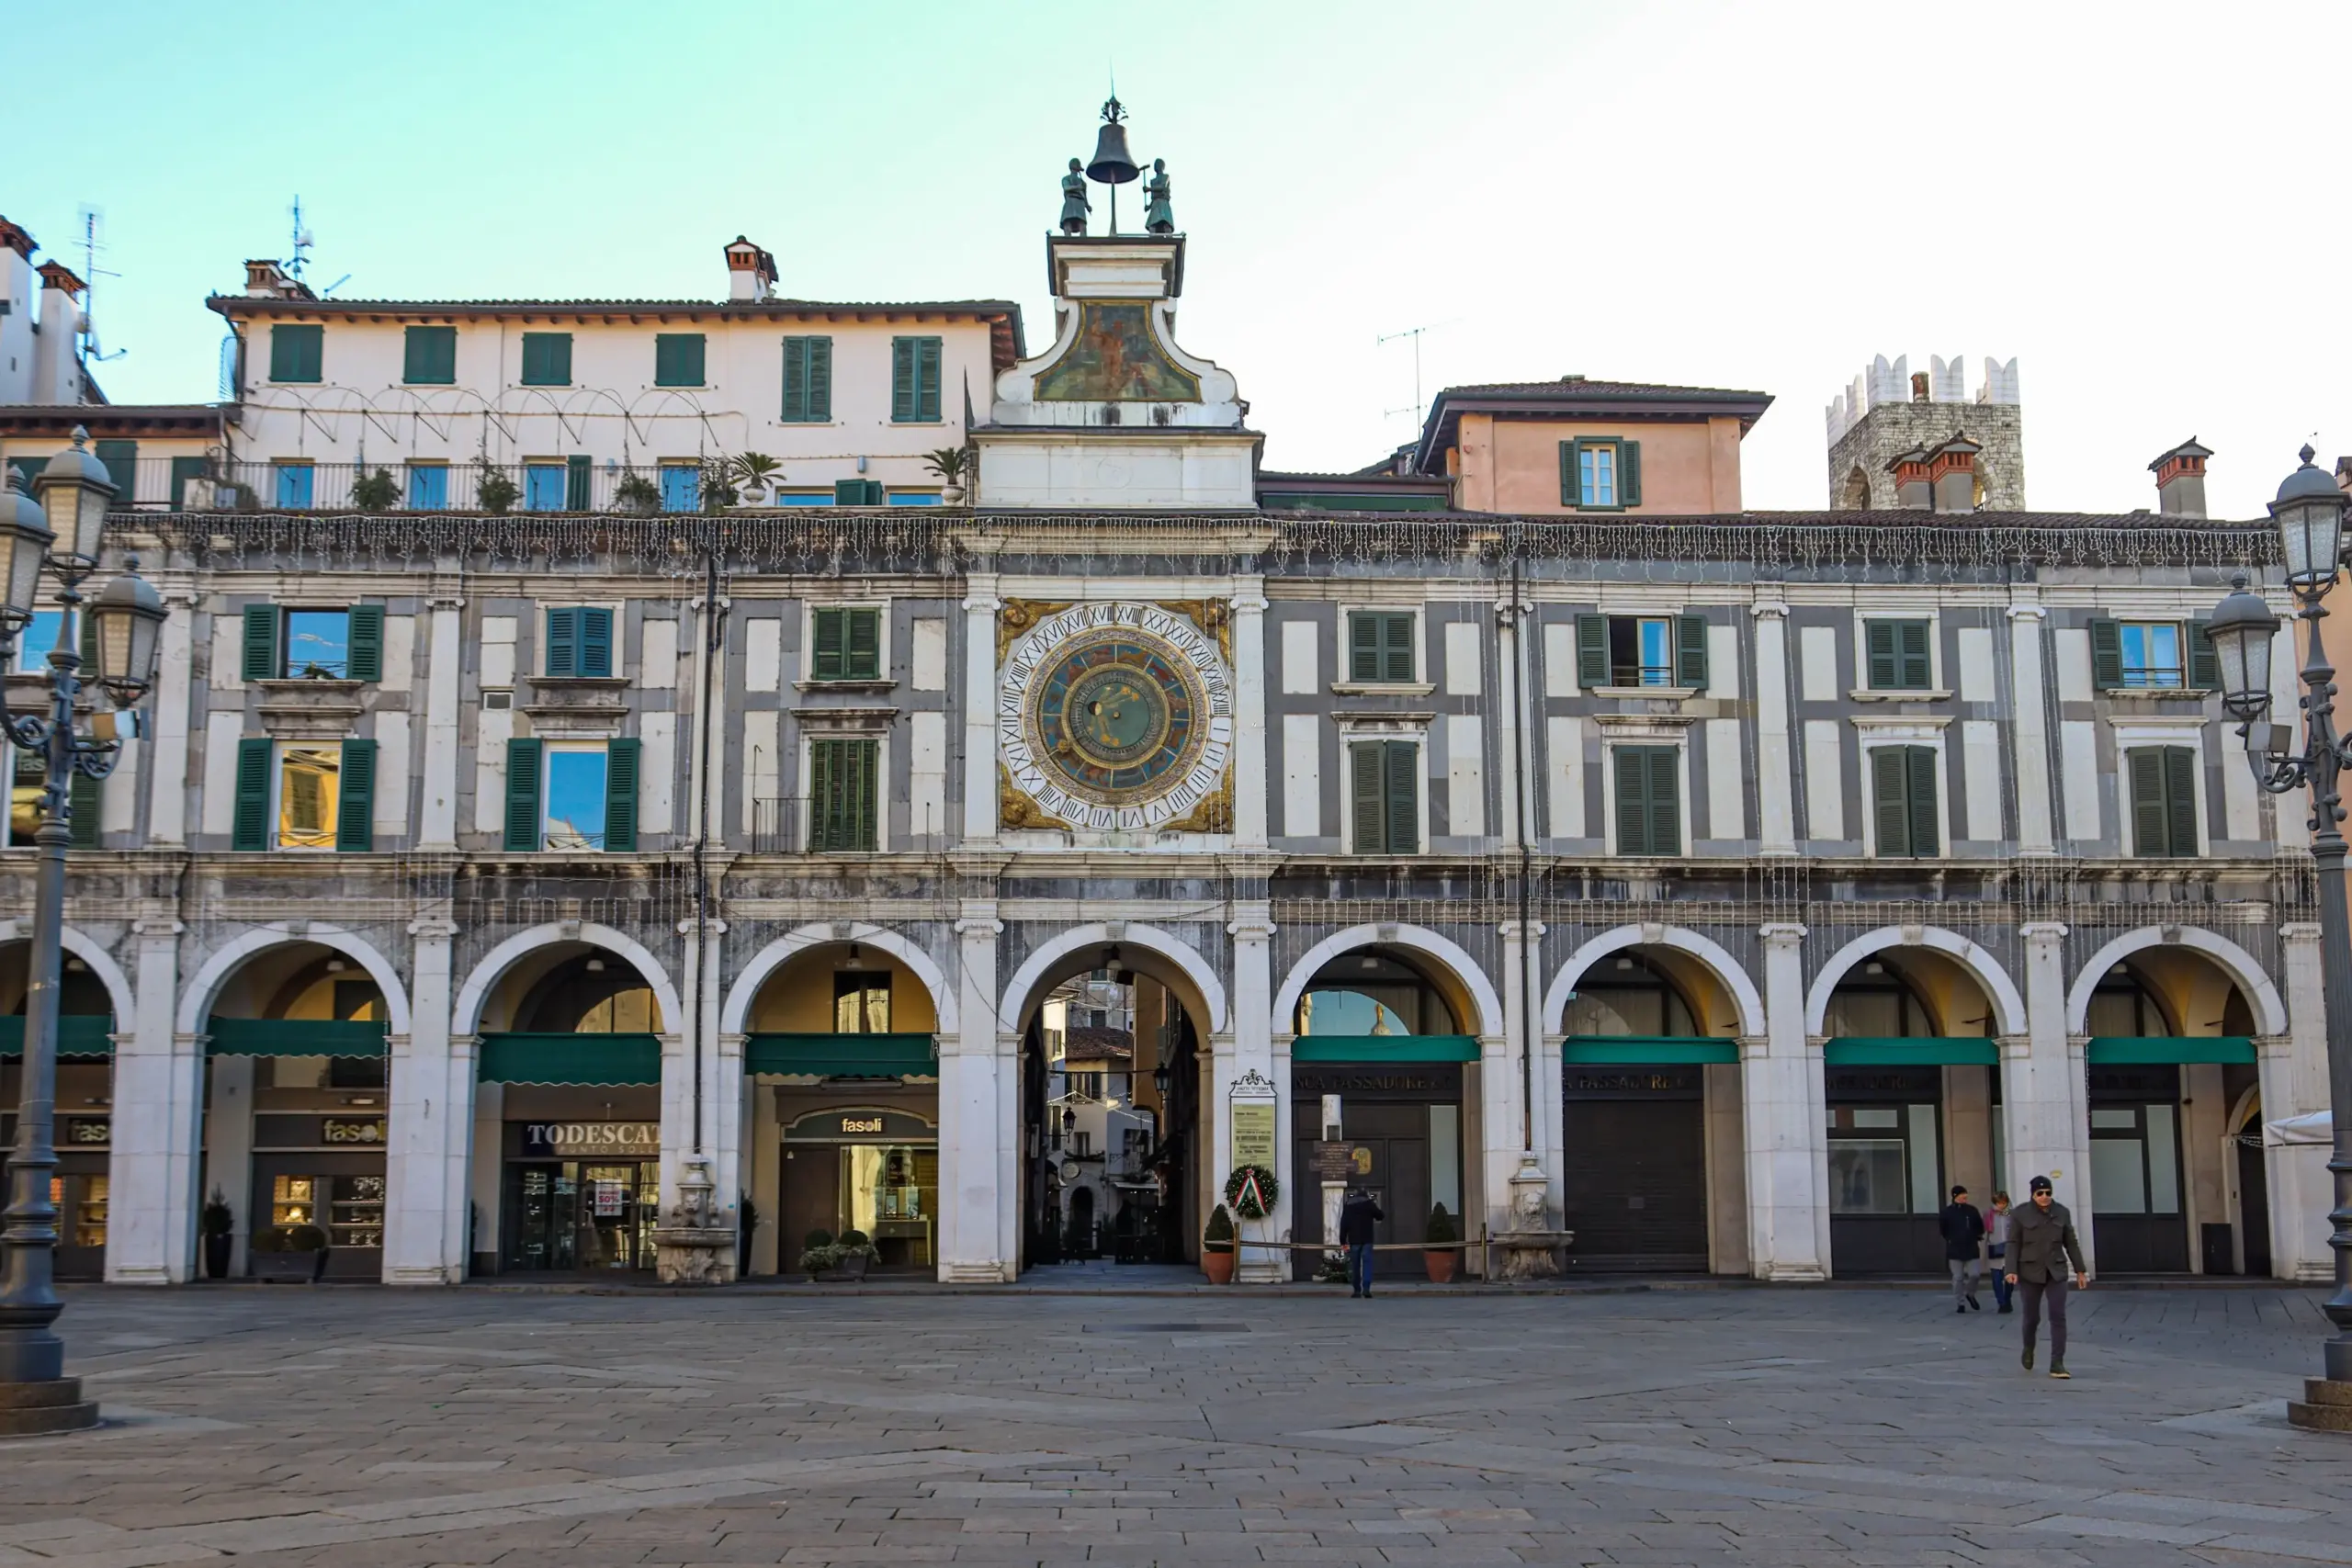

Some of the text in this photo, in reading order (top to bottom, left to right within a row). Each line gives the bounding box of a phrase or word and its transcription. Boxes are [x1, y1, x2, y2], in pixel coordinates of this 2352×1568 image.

[1062, 610, 1088, 632] XVII
[1090, 606, 1114, 624] XVIII
[1144, 611, 1168, 632] XX
[1038, 622, 1064, 647] XVI
[1167, 626, 1193, 646] XXI
[1019, 640, 1042, 666] XV
[1187, 641, 1212, 666] XXII
[1001, 692, 1020, 714] XIII
[1002, 720, 1020, 740] XII
[1008, 747, 1029, 767] XI
[1205, 749, 1224, 762] II
[1023, 771, 1042, 788] X
[1192, 770, 1210, 789] III
[1170, 787, 1193, 808] IIII
[1092, 809, 1114, 827] VII
[1123, 811, 1141, 827] VI
[1154, 805, 1167, 820] V
[842, 1118, 882, 1132] fasoli
